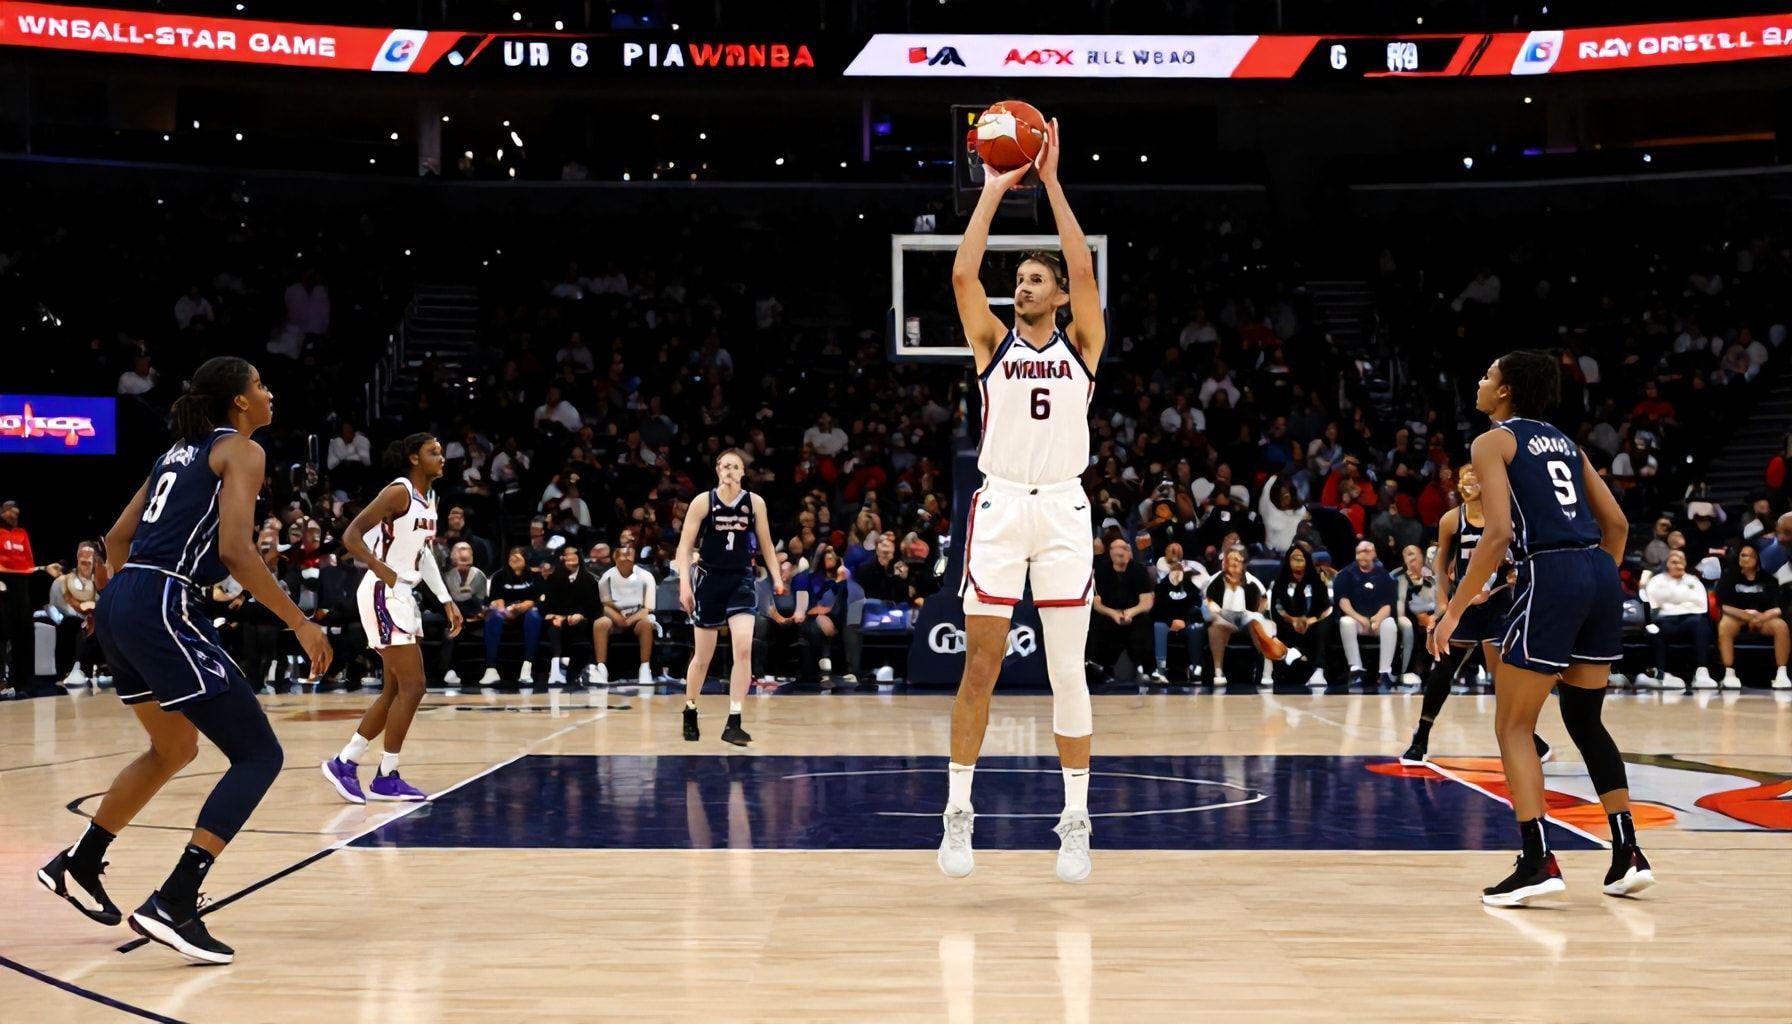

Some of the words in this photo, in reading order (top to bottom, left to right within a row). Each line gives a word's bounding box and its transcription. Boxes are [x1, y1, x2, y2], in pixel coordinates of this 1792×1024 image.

[249, 33, 336, 57] GAME
[570, 42, 589, 67] 6
[1030, 387, 1051, 420] 6
